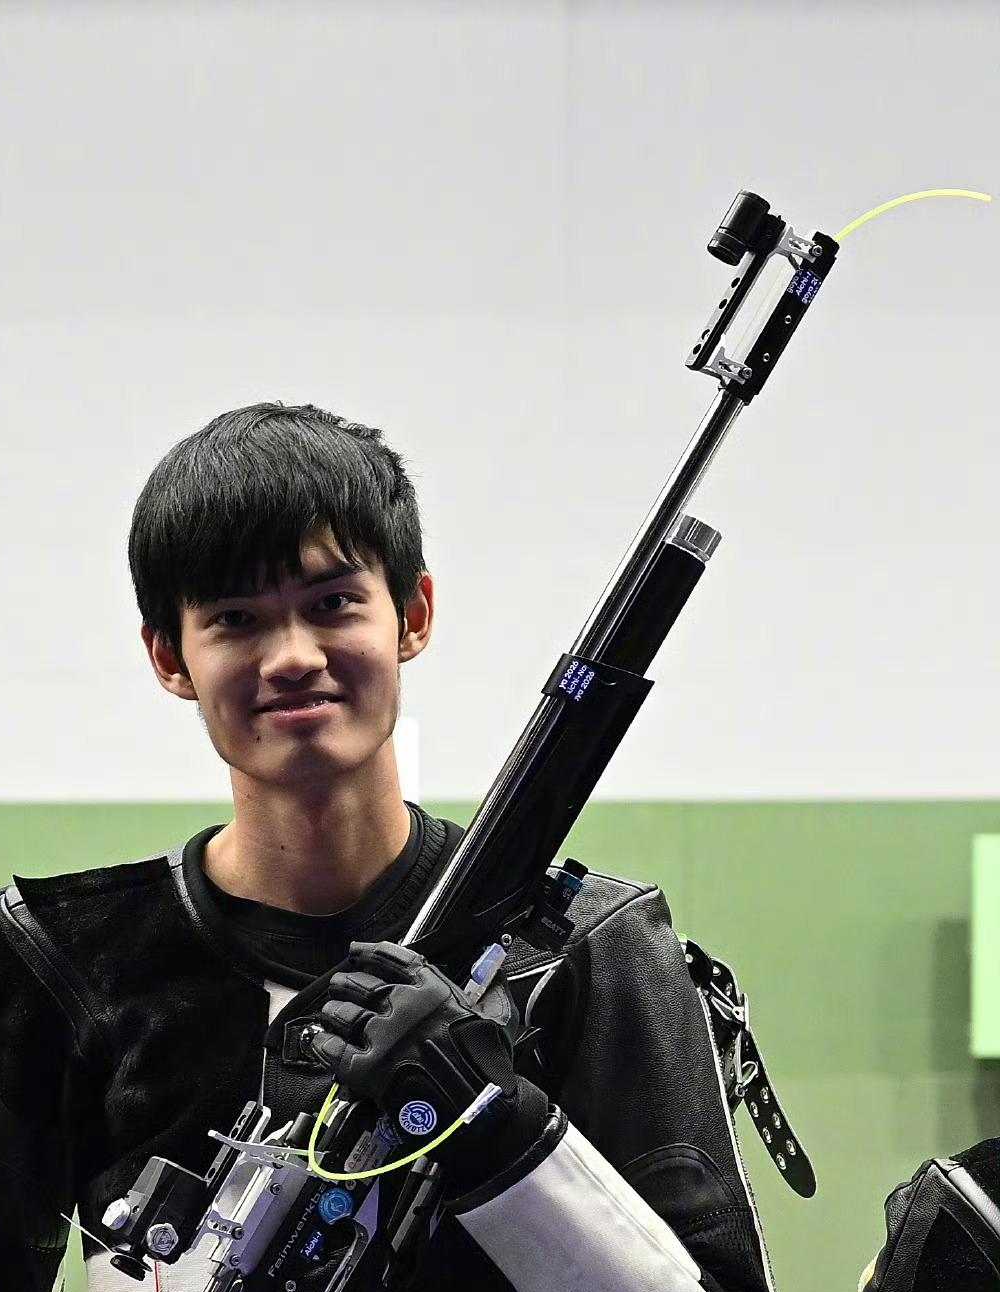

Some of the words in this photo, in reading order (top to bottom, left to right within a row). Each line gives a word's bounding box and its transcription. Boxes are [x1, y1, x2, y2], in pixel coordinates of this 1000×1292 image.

[564, 660, 579, 679] 2026
[580, 671, 595, 690] 2026
[268, 1183, 325, 1276] Feinwerkba
